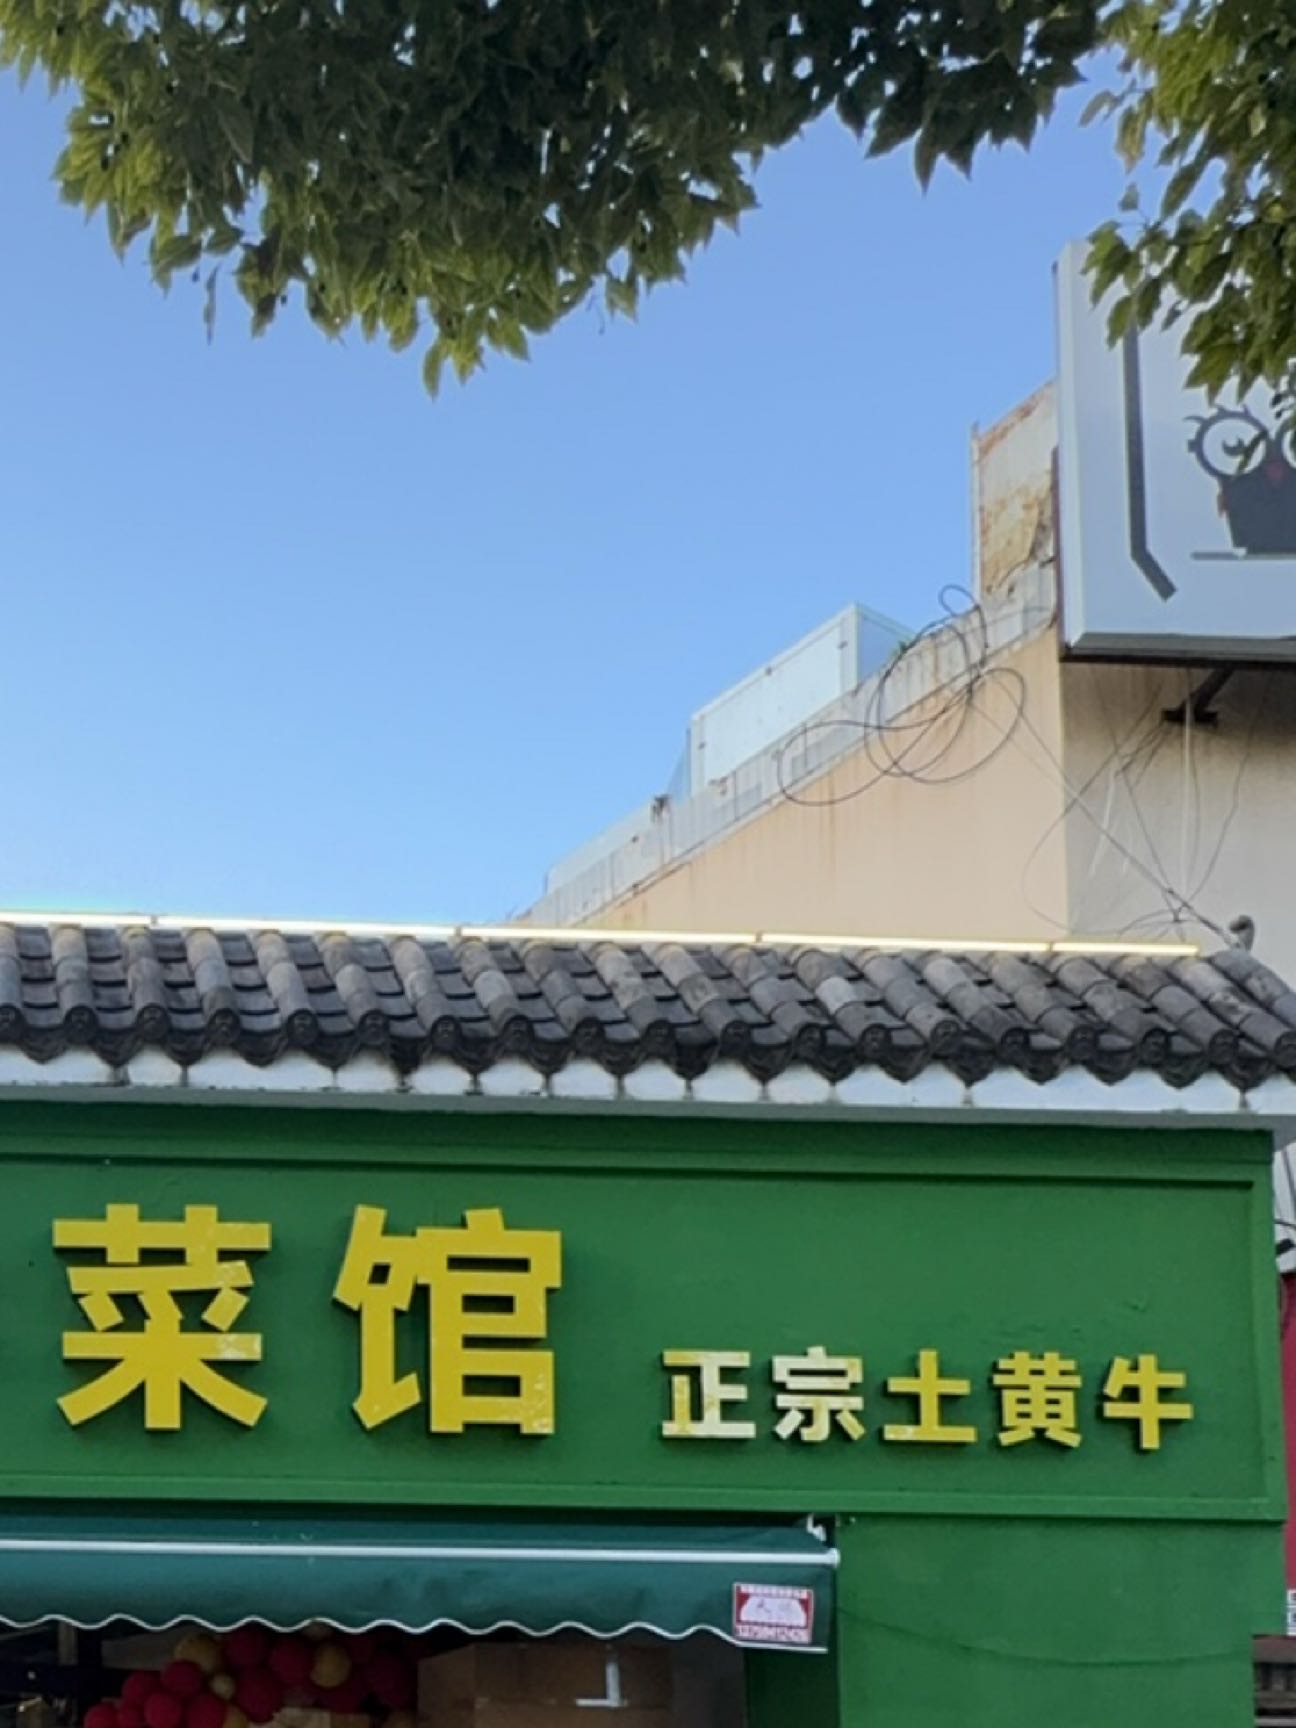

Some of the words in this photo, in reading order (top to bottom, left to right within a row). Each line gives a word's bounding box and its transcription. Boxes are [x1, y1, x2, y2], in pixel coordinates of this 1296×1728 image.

[662, 1346, 1195, 1450] 正宗土黄牛
